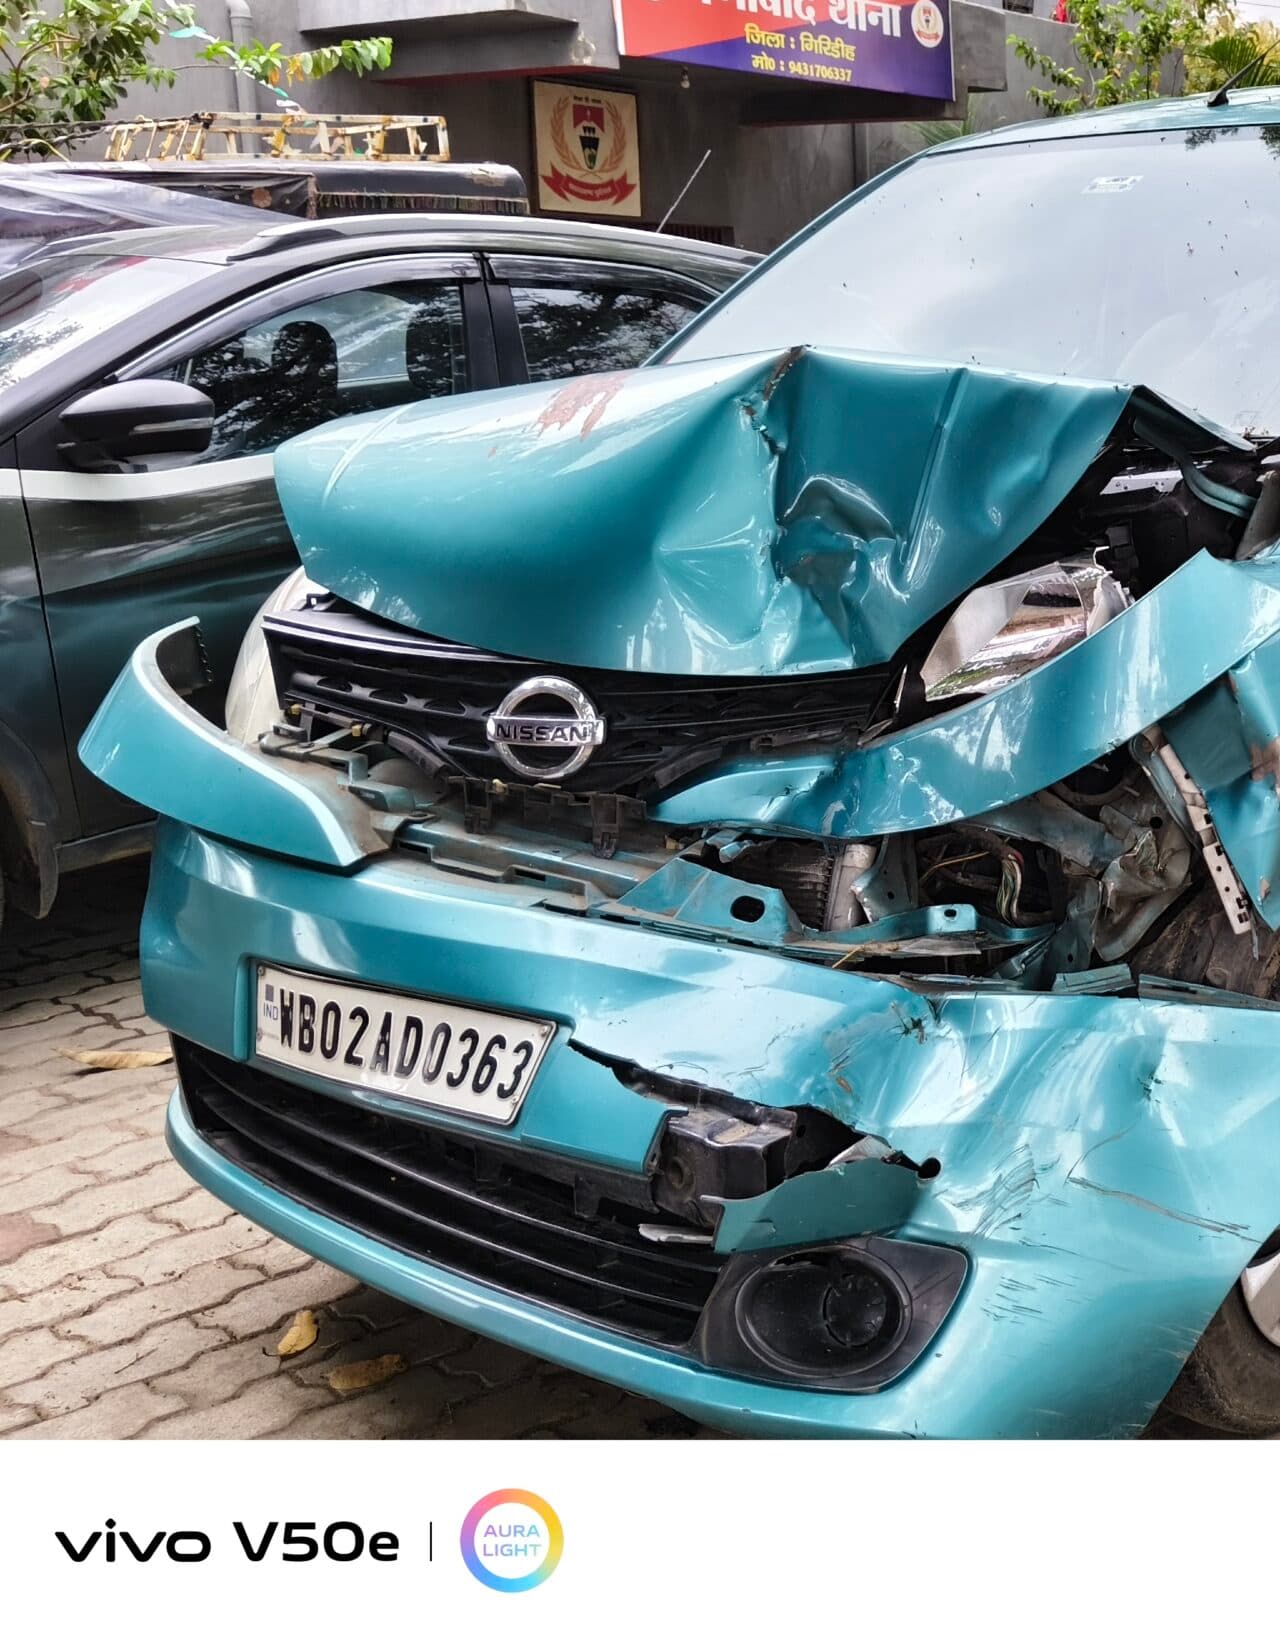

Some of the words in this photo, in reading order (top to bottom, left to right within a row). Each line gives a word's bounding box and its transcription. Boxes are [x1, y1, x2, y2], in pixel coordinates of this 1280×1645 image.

[828, 0, 902, 38] थाना
[744, 22, 786, 49] जिला
[799, 31, 857, 62] गिरिडीह
[788, 60, 852, 82] 9431706337
[496, 725, 588, 742] NISSAN
[264, 1001, 279, 1020] IND
[280, 988, 534, 1100] WB02AD0363
